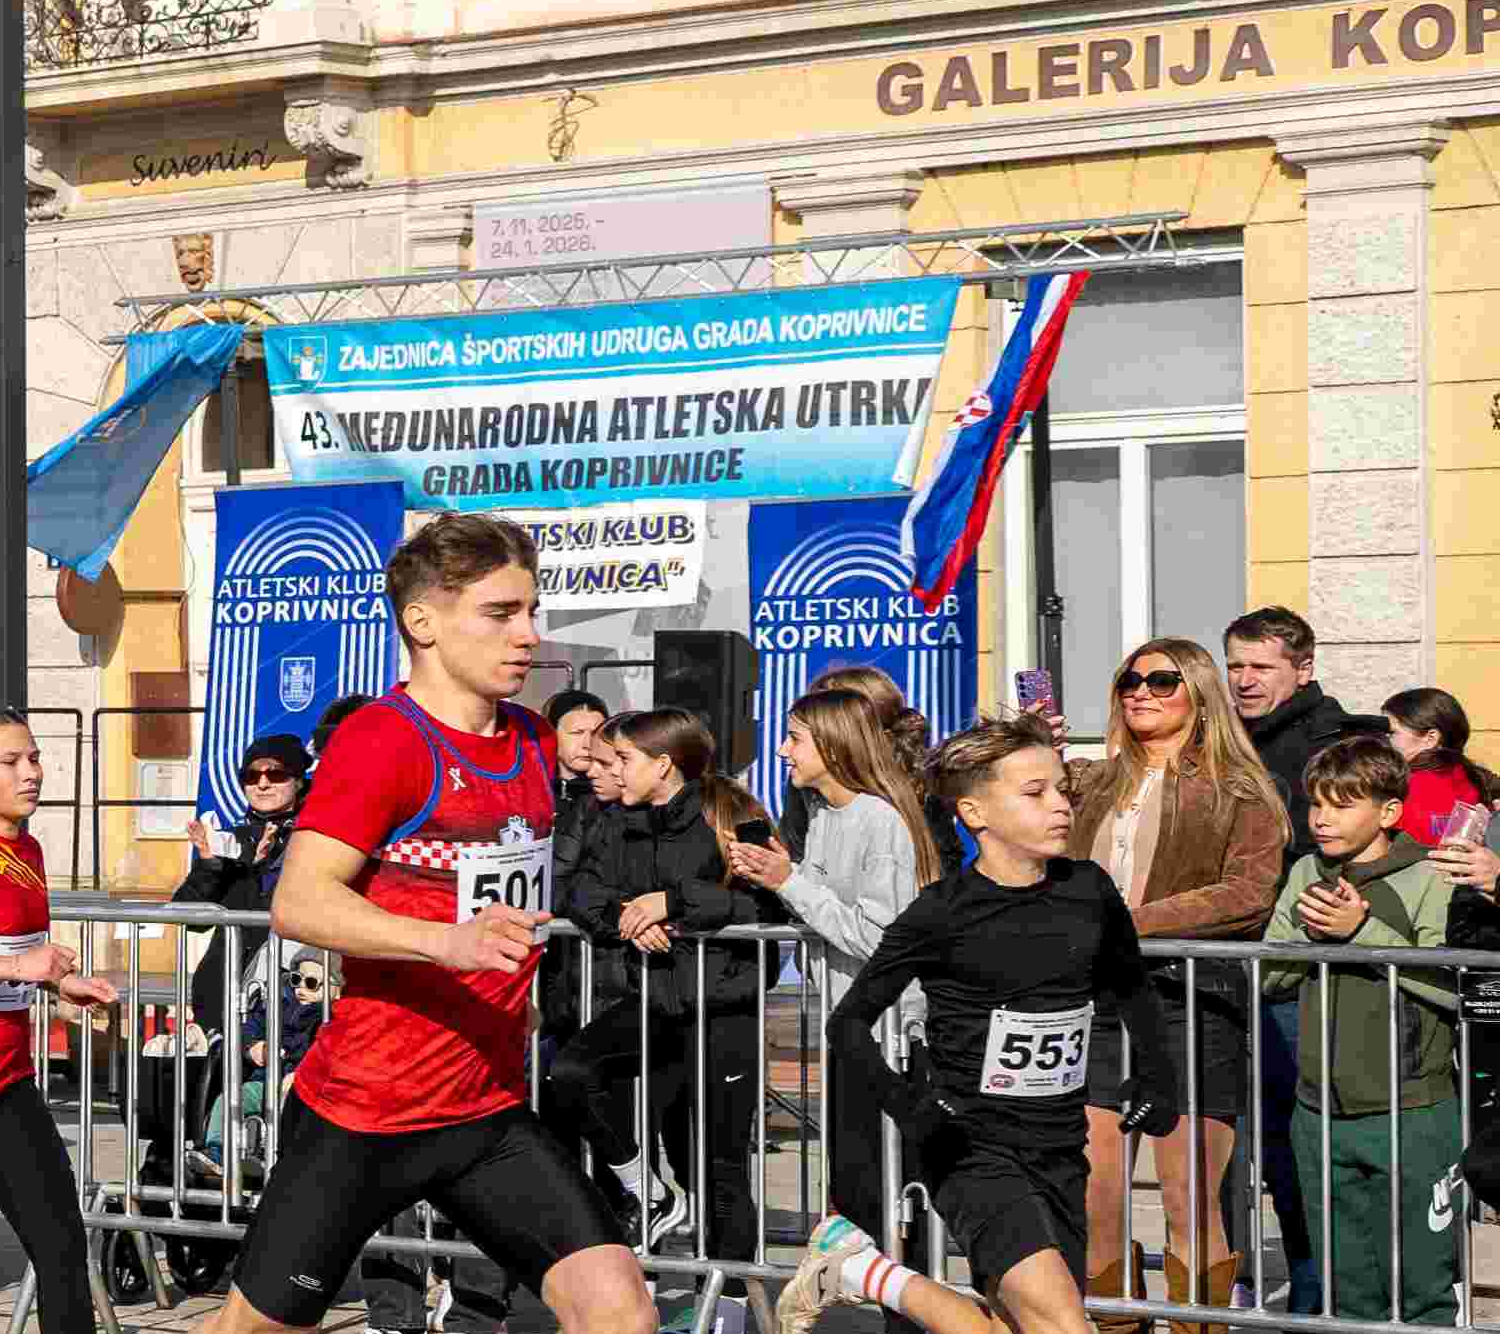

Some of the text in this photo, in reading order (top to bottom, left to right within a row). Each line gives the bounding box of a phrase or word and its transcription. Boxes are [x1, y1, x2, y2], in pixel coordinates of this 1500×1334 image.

[876, 23, 1275, 116] GALERIJA
[338, 303, 928, 372] ZAJEDNICA ŠPORTSKIH UDRUGA GRADA KOPRIVNICE
[300, 411, 339, 450] 43.
[607, 386, 786, 443] ATLETSKA
[422, 447, 745, 496] GRADA KOPRIVNICE
[600, 515, 694, 547] KLUB
[217, 573, 387, 600] ATLETSKI KLUB
[215, 597, 389, 624] KOPRIVNICA
[754, 597, 879, 622] ATLETSKI
[754, 621, 963, 650] KOPRIVNICA
[998, 1028, 1085, 1071] 553
